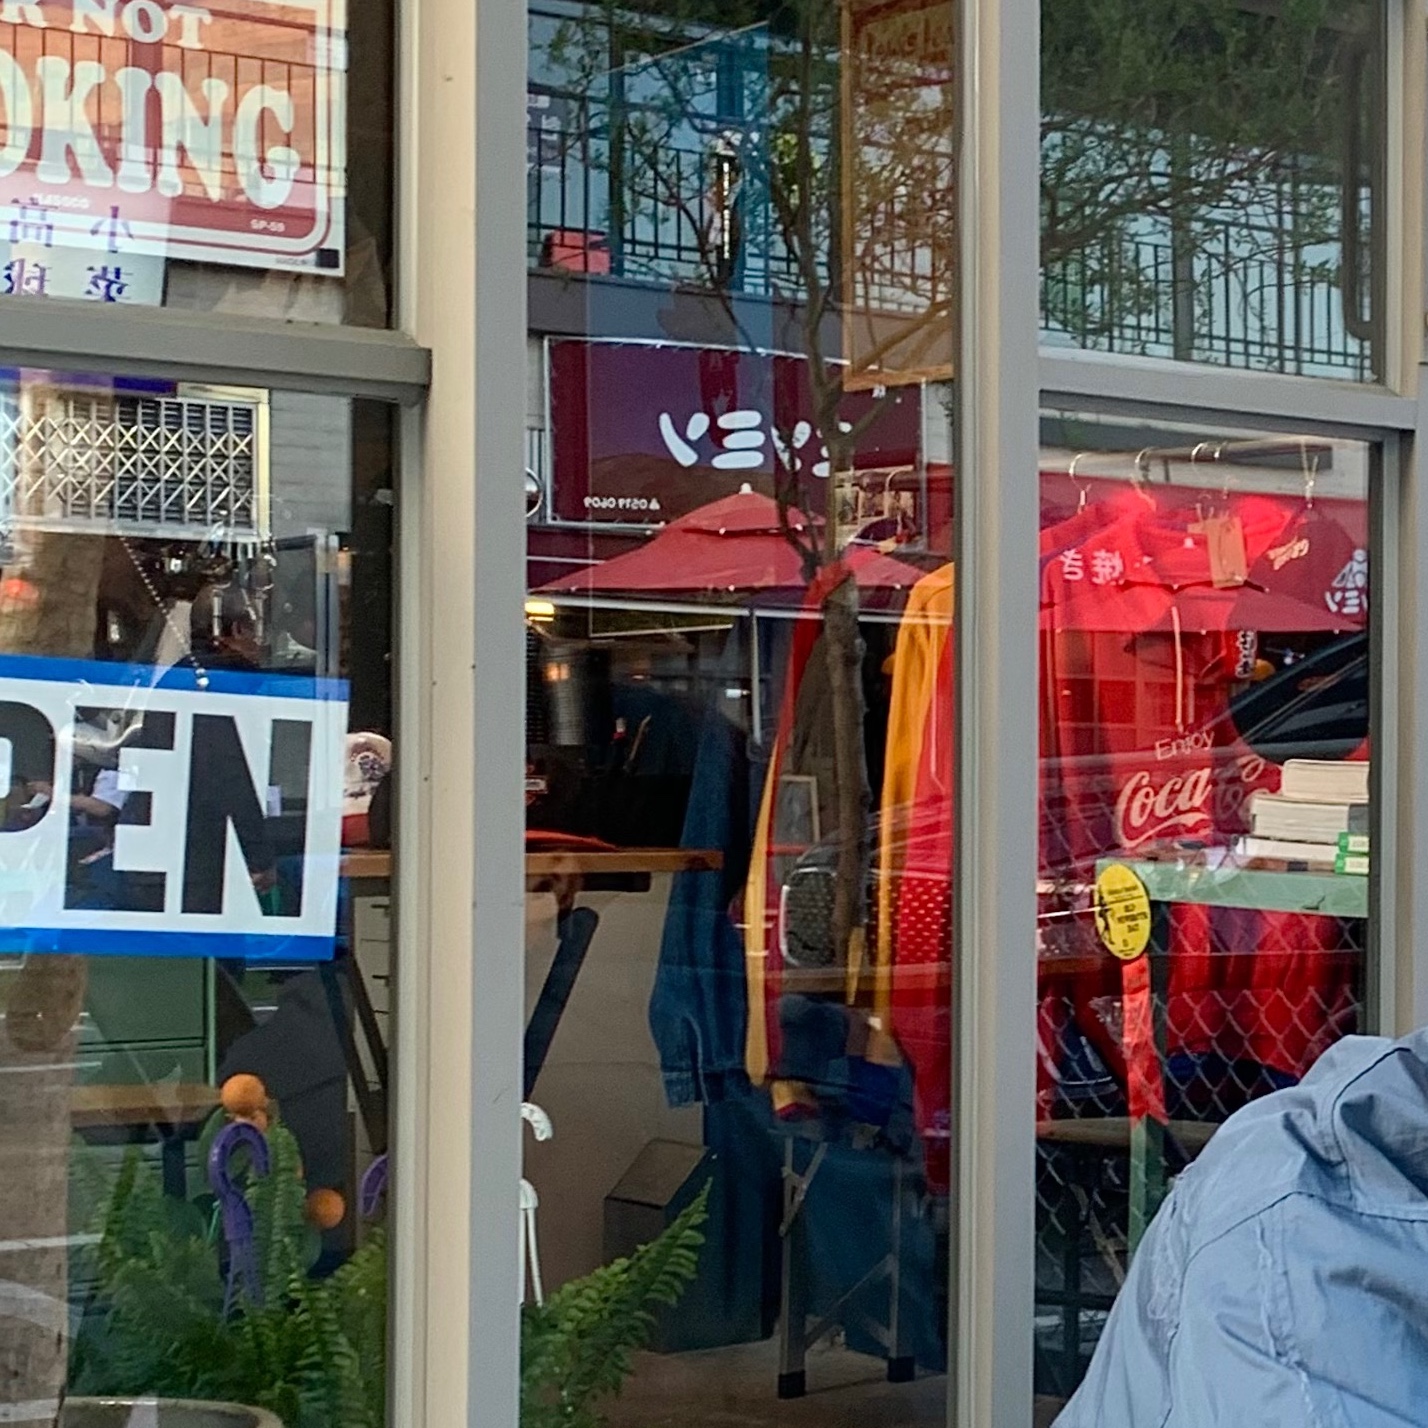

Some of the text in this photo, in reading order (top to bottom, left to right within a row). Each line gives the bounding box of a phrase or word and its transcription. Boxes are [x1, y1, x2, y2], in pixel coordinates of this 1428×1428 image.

[69, 0, 214, 49] NOT
[1155, 730, 1215, 761] Enjoy
[1116, 767, 1212, 849] Coca
